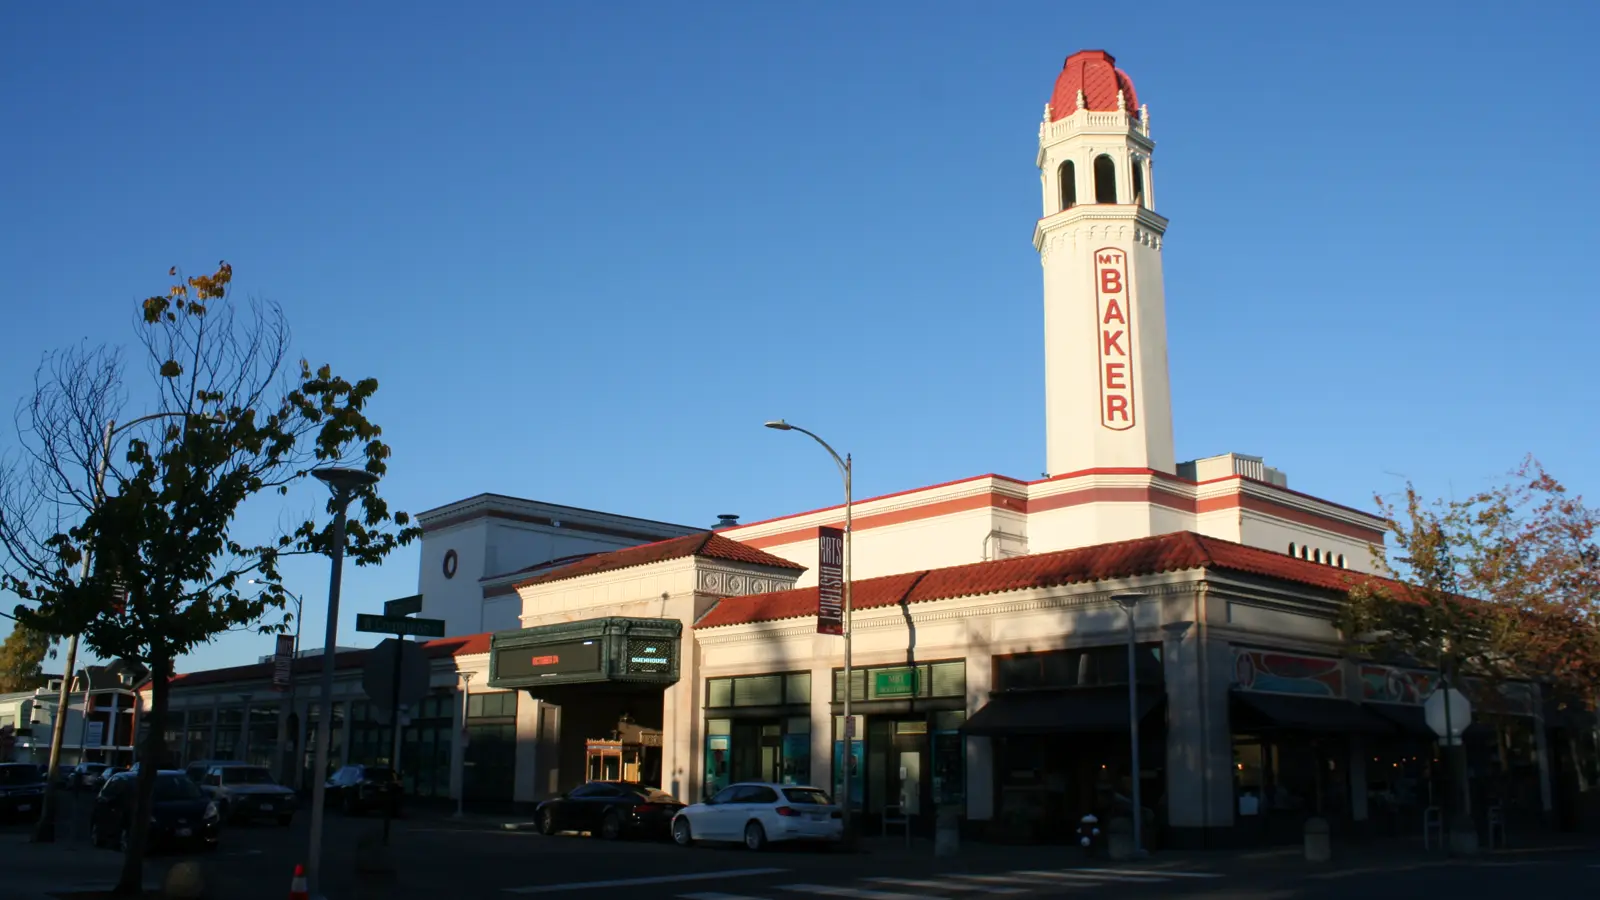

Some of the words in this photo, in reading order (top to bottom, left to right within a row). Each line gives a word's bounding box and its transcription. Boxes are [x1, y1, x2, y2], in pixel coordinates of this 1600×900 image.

[1098, 254, 1122, 265] MT
[1101, 268, 1129, 422] BAKER
[820, 536, 842, 565] ARTS
[819, 566, 842, 624] DISTRICT
